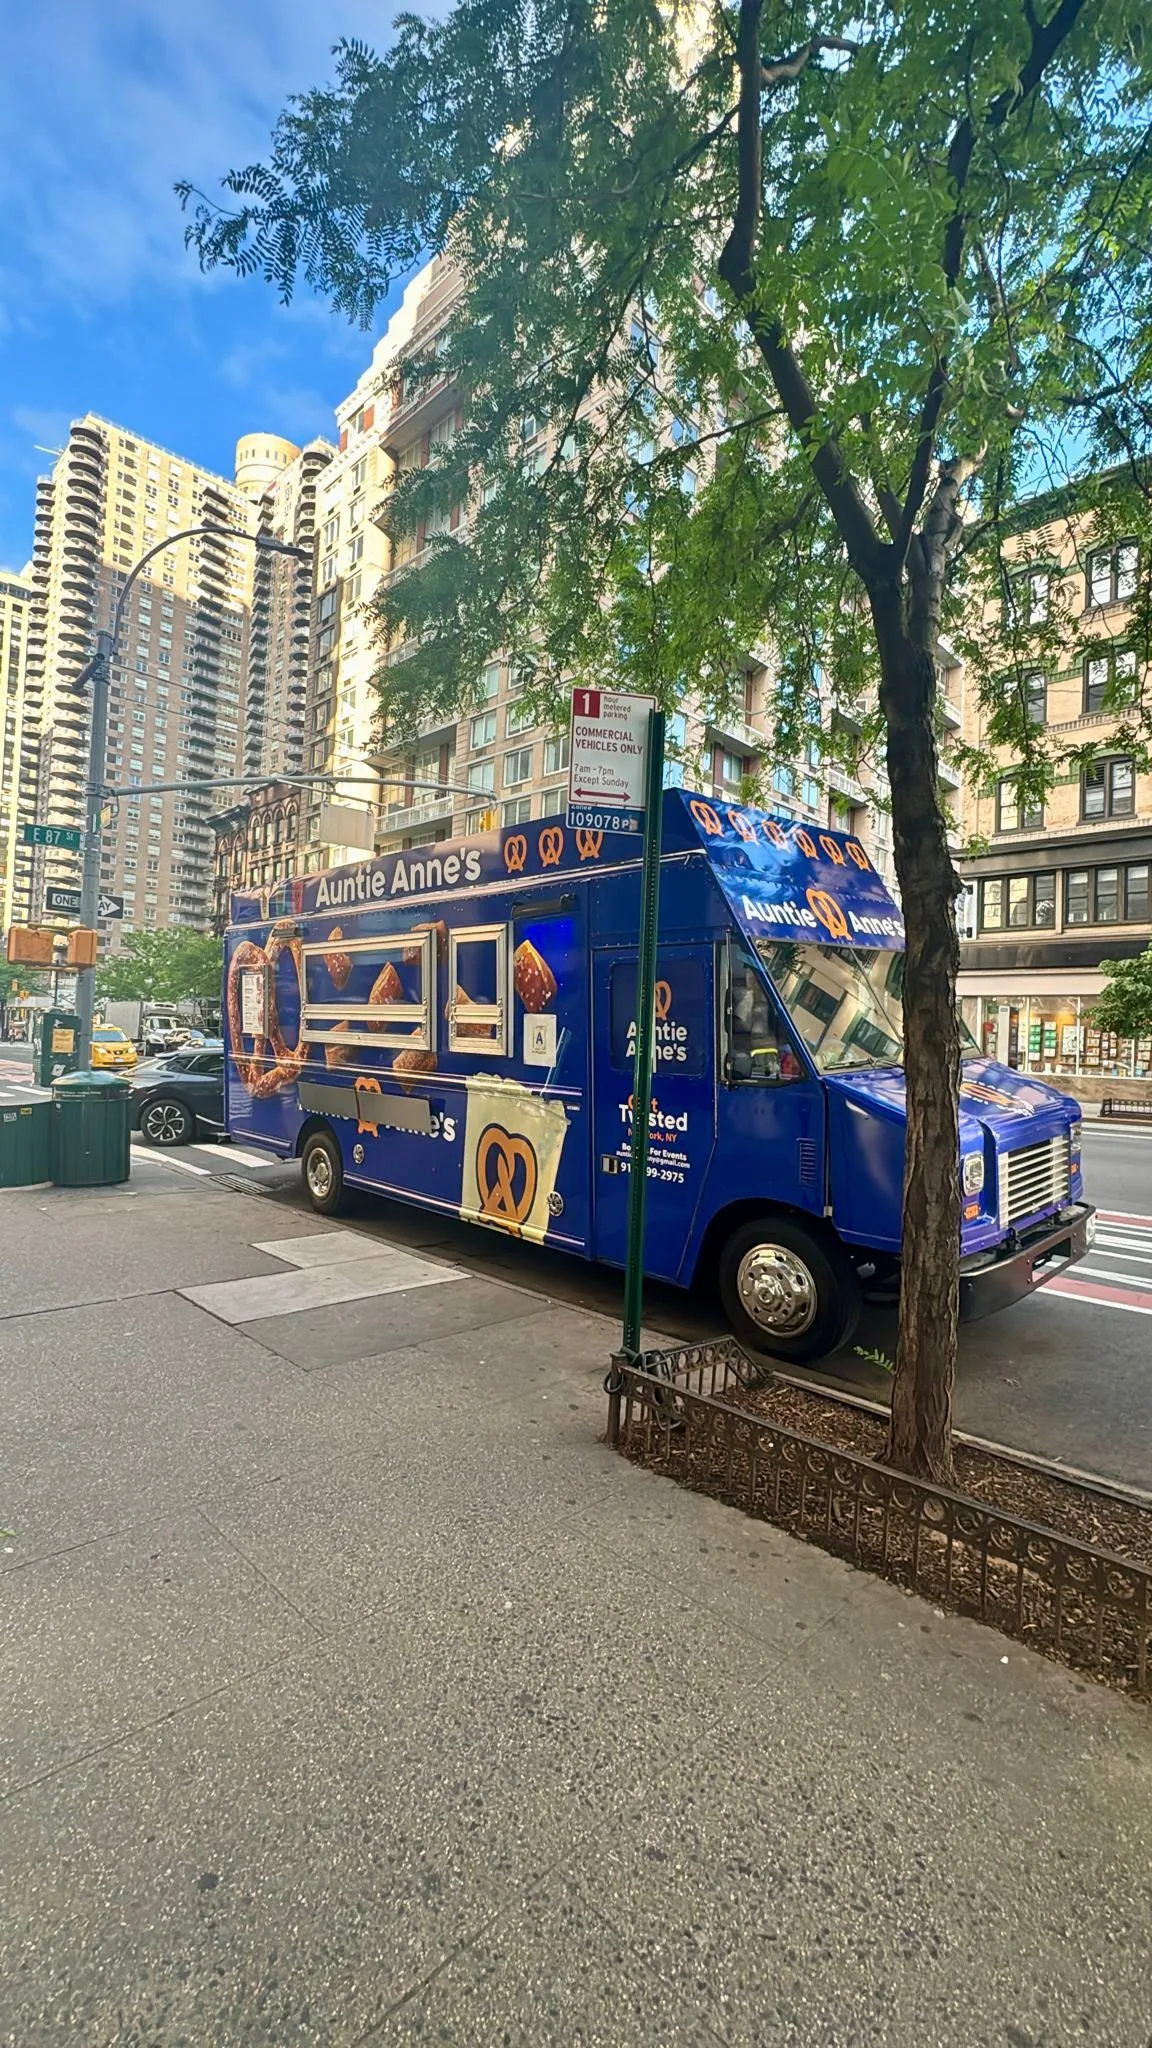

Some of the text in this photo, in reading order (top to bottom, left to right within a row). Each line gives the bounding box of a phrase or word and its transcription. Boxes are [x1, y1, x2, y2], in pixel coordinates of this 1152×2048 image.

[582, 692, 590, 715] 1
[603, 695, 619, 703] hour
[603, 703, 631, 712] metered
[603, 710, 628, 721] parking
[575, 726, 634, 742] COMMERCIAL
[575, 738, 643, 755] VEHICLES ONLY
[574, 763, 591, 773] 7am
[598, 766, 614, 777] 7pm
[574, 774, 629, 789] Except Sunday
[570, 811, 620, 830] 109078
[33, 827, 41, 842] E
[45, 829, 61, 844] 87
[315, 847, 481, 908] Auntie Anne's
[55, 895, 77, 906] ONE
[98, 901, 111, 910] AY
[741, 894, 905, 938] Auntie Anne's
[535, 1031, 544, 1045] A
[626, 1021, 688, 1041] Antie
[625, 1040, 687, 1062] Ane's
[665, 1133, 677, 1143] NY
[649, 1147, 661, 1156] For
[662, 1149, 687, 1161] Events
